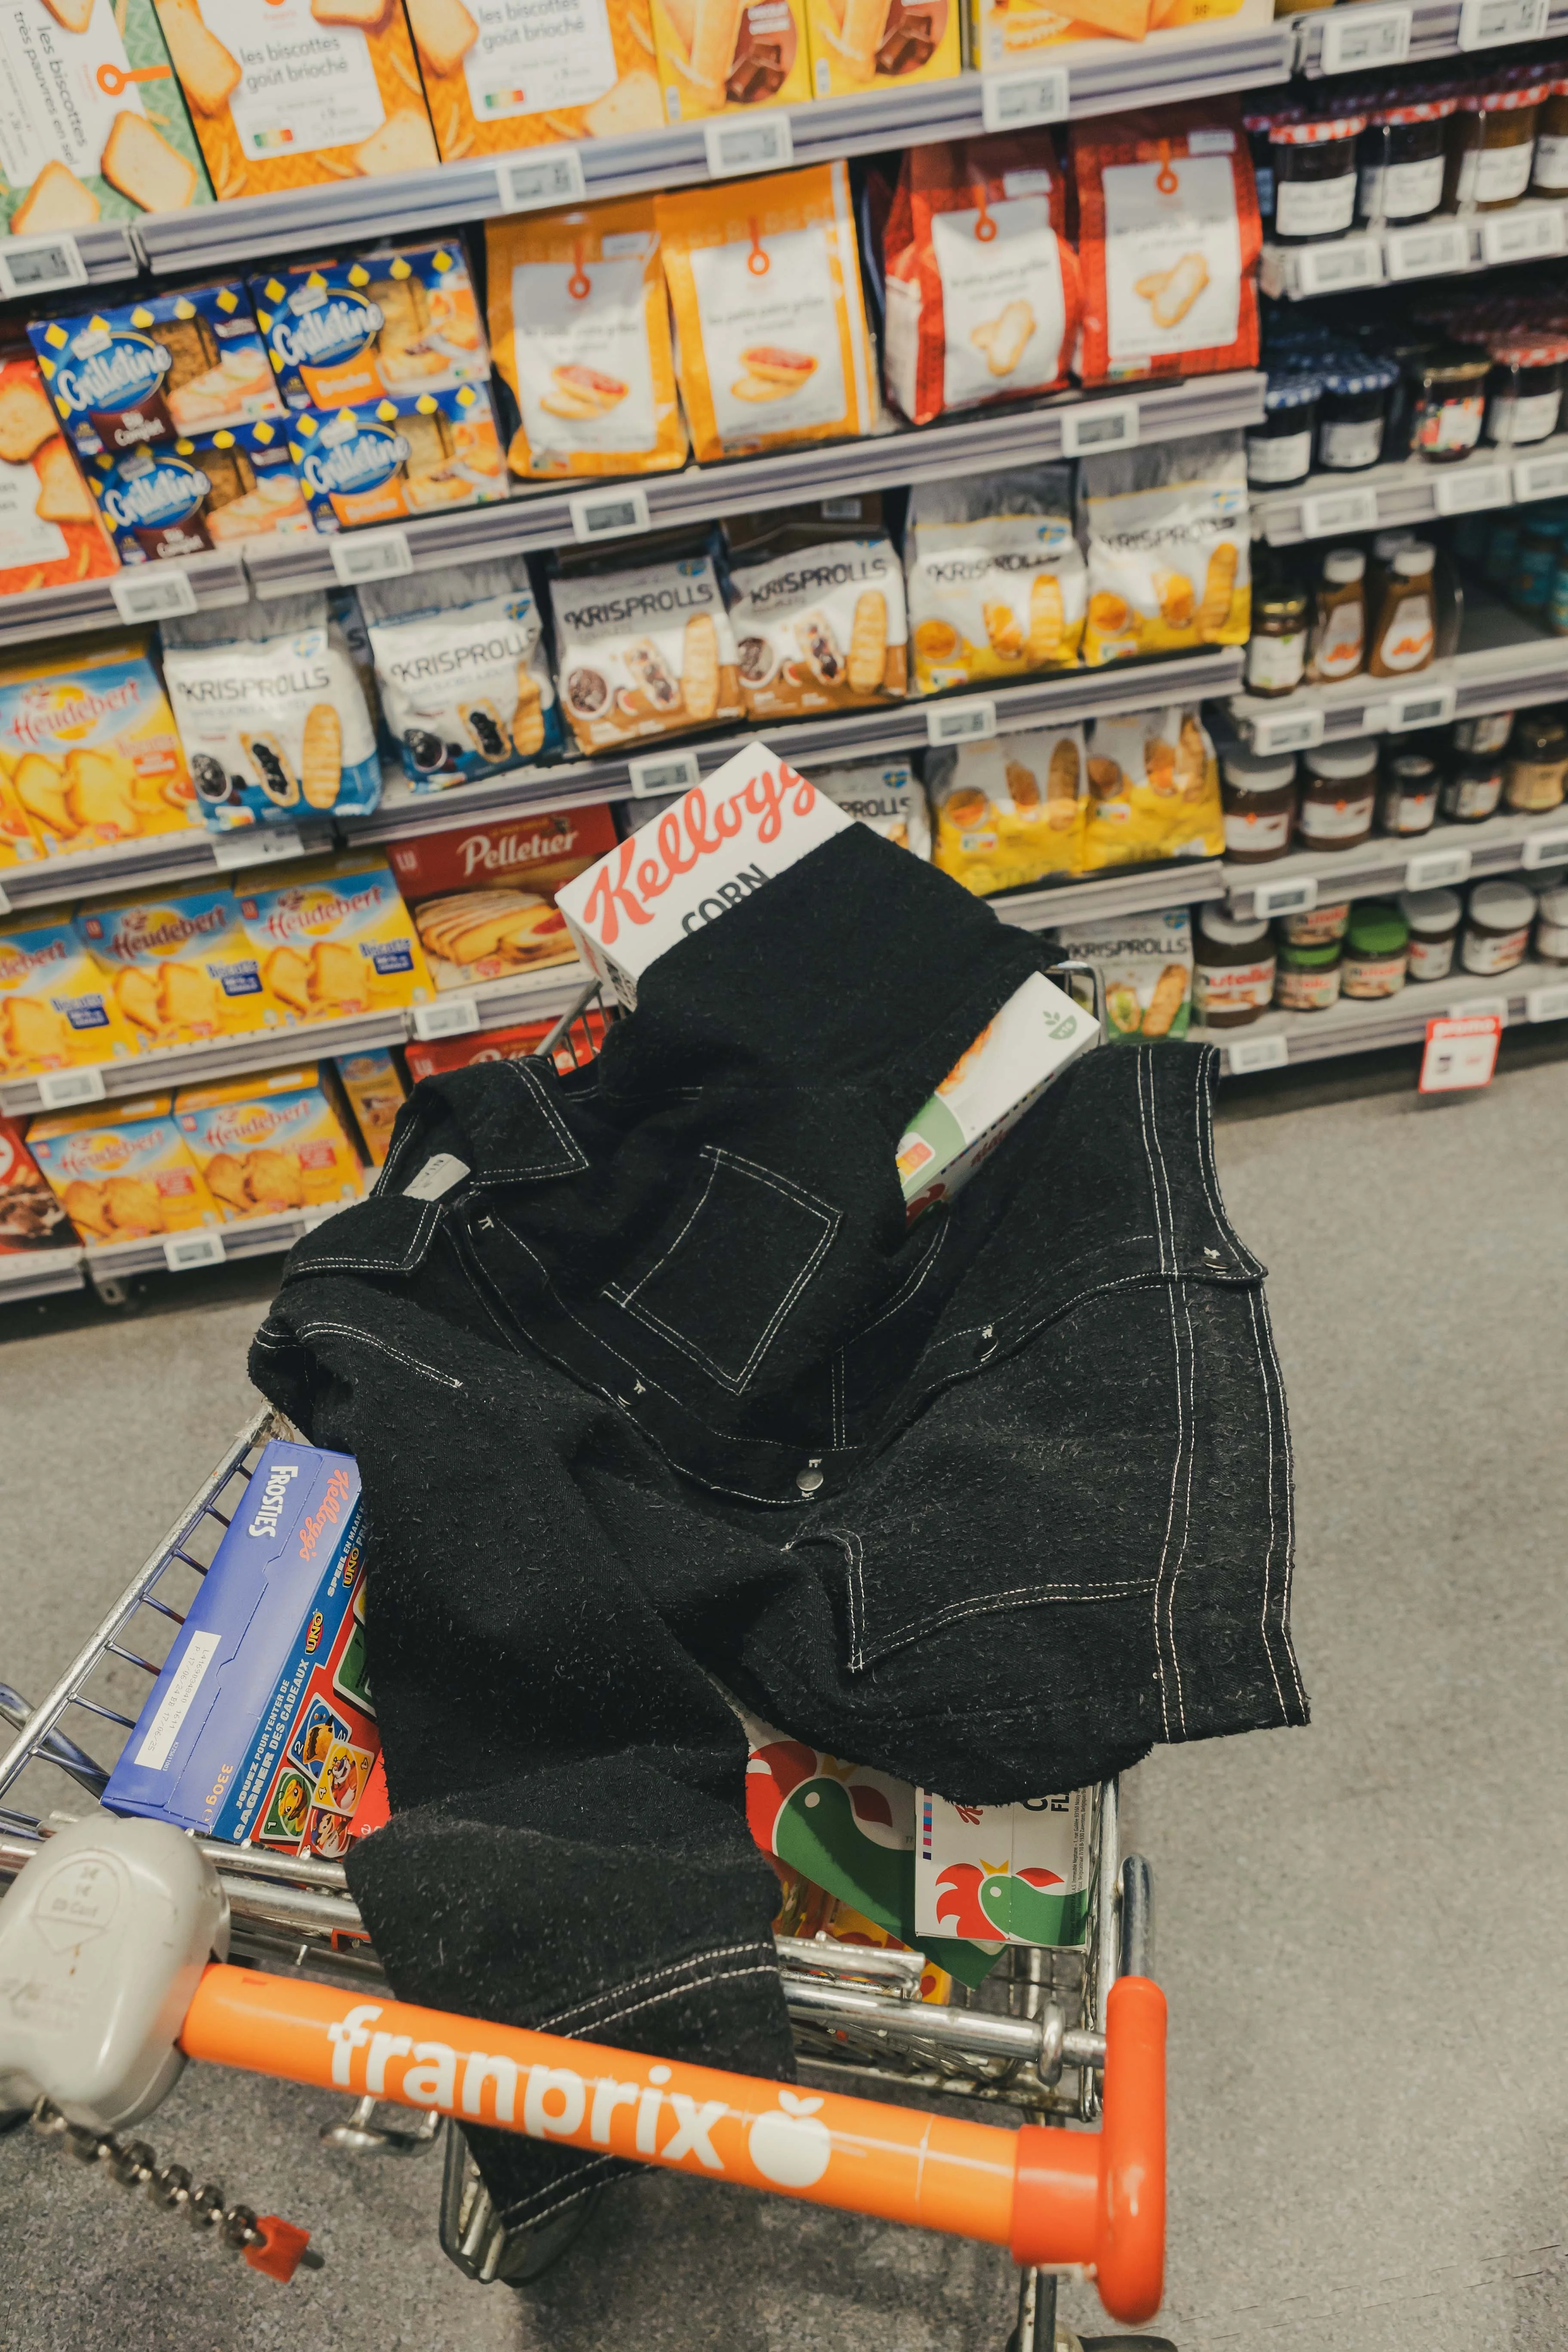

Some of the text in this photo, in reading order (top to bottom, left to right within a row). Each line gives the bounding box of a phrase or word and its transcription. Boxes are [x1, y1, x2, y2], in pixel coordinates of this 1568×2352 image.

[14, 11, 32, 45] très
[24, 49, 58, 116] pauvres
[52, 119, 66, 140] en
[239, 38, 340, 65] les biscottes
[37, 25, 88, 147] les biscottes
[564, 583, 714, 629] KRISPROLLS
[390, 626, 539, 682] KRISPROLLS
[176, 667, 331, 702] KRISPROLLS
[7, 677, 141, 746] Heudebert
[838, 796, 910, 818] PROLLS
[456, 829, 579, 876] Pelletier
[104, 905, 226, 960] Heudebert
[260, 885, 382, 940] Heudebert
[1067, 937, 1188, 959] KRISPROLLS
[199, 1098, 311, 1148] Heudebert
[55, 1129, 164, 1175] Heudebert
[248, 1466, 299, 1537] FROSTIES
[300, 1468, 349, 1562] Kellogg's
[327, 1555, 347, 1597] SPEEL
[343, 1540, 352, 1554] EN
[348, 1513, 362, 1541] MAAK
[342, 1547, 359, 1588] UNO
[175, 1657, 196, 1694] 17/06/24
[148, 1712, 170, 1752] 17/06/25
[233, 1611, 324, 1841] GAGNER DES CADEAUX UNO
[236, 1679, 291, 1810] JOUEZ POUR TENTER DE
[294, 1740, 303, 1755] 2
[206, 1763, 233, 1806] 330g
[268, 1821, 277, 1831] 1
[328, 2005, 729, 2170] franprix
